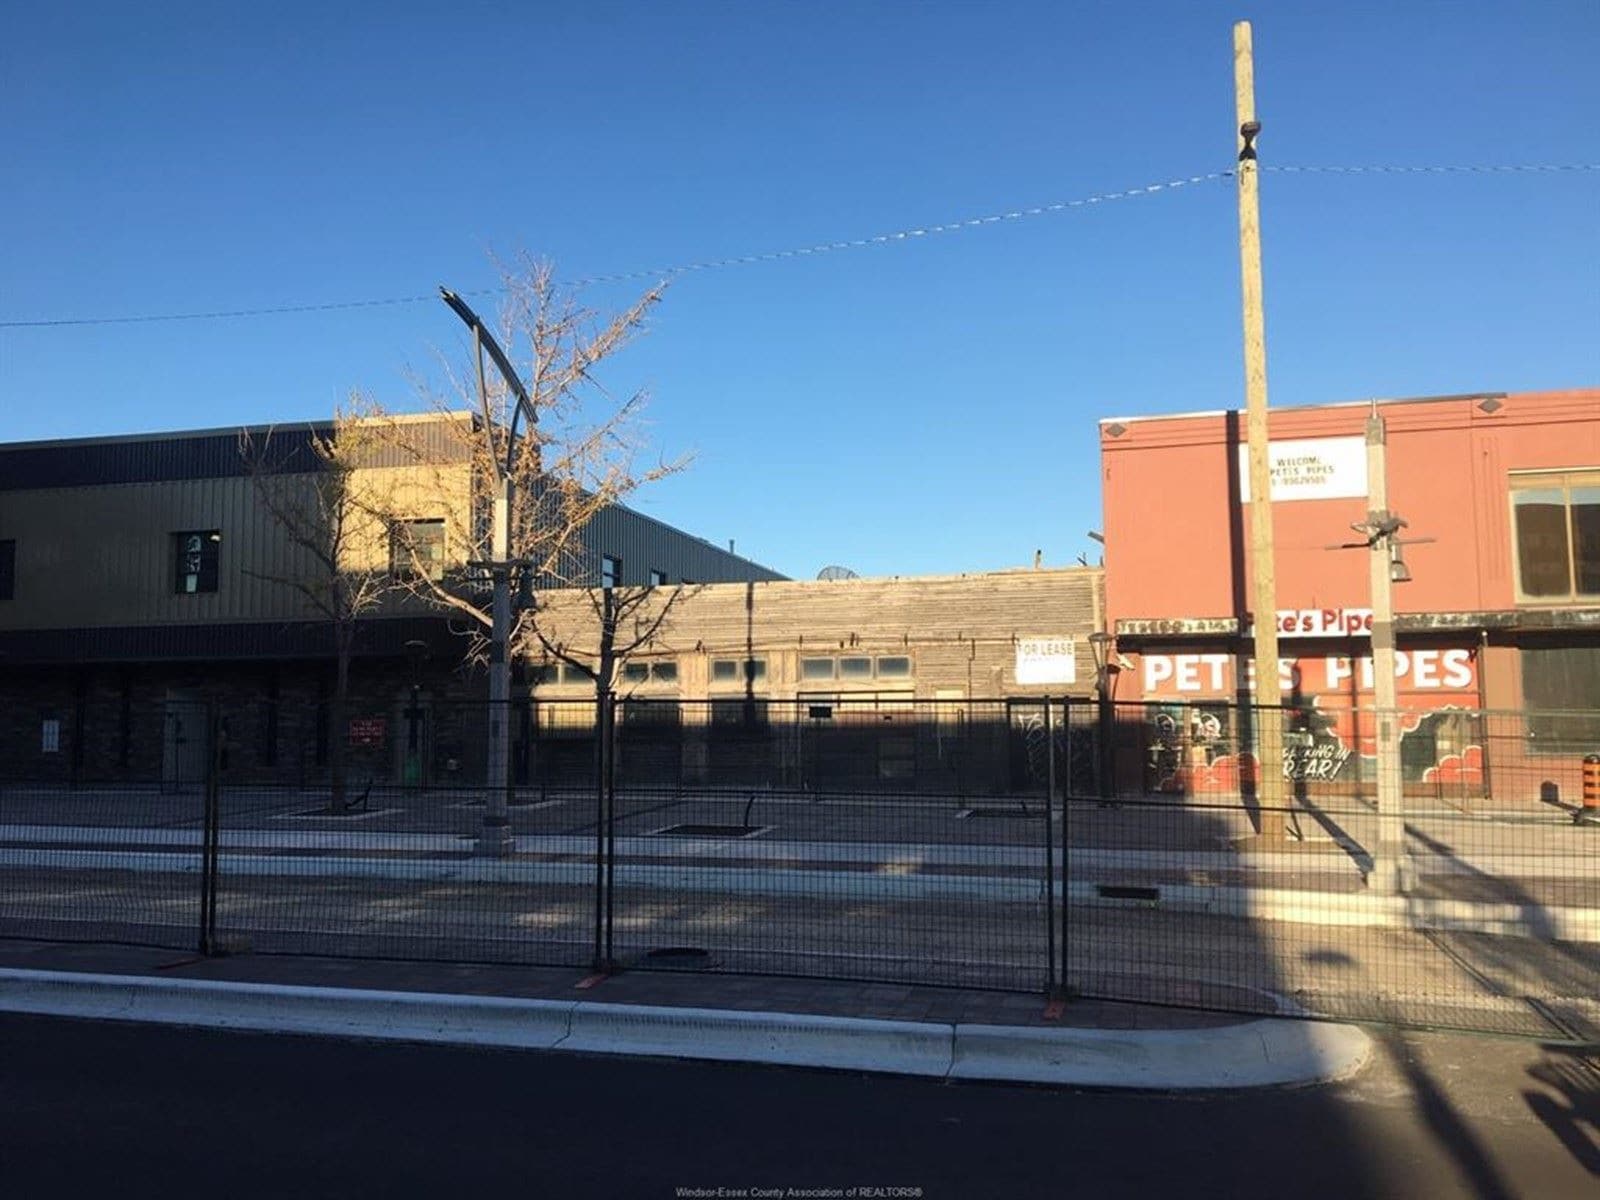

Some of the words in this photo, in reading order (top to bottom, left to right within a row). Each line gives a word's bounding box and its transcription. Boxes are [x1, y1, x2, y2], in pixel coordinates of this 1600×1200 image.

[1321, 607, 1374, 636] Pipe
[1040, 642, 1072, 656] LEASE
[1282, 744, 1335, 759] PAKING
